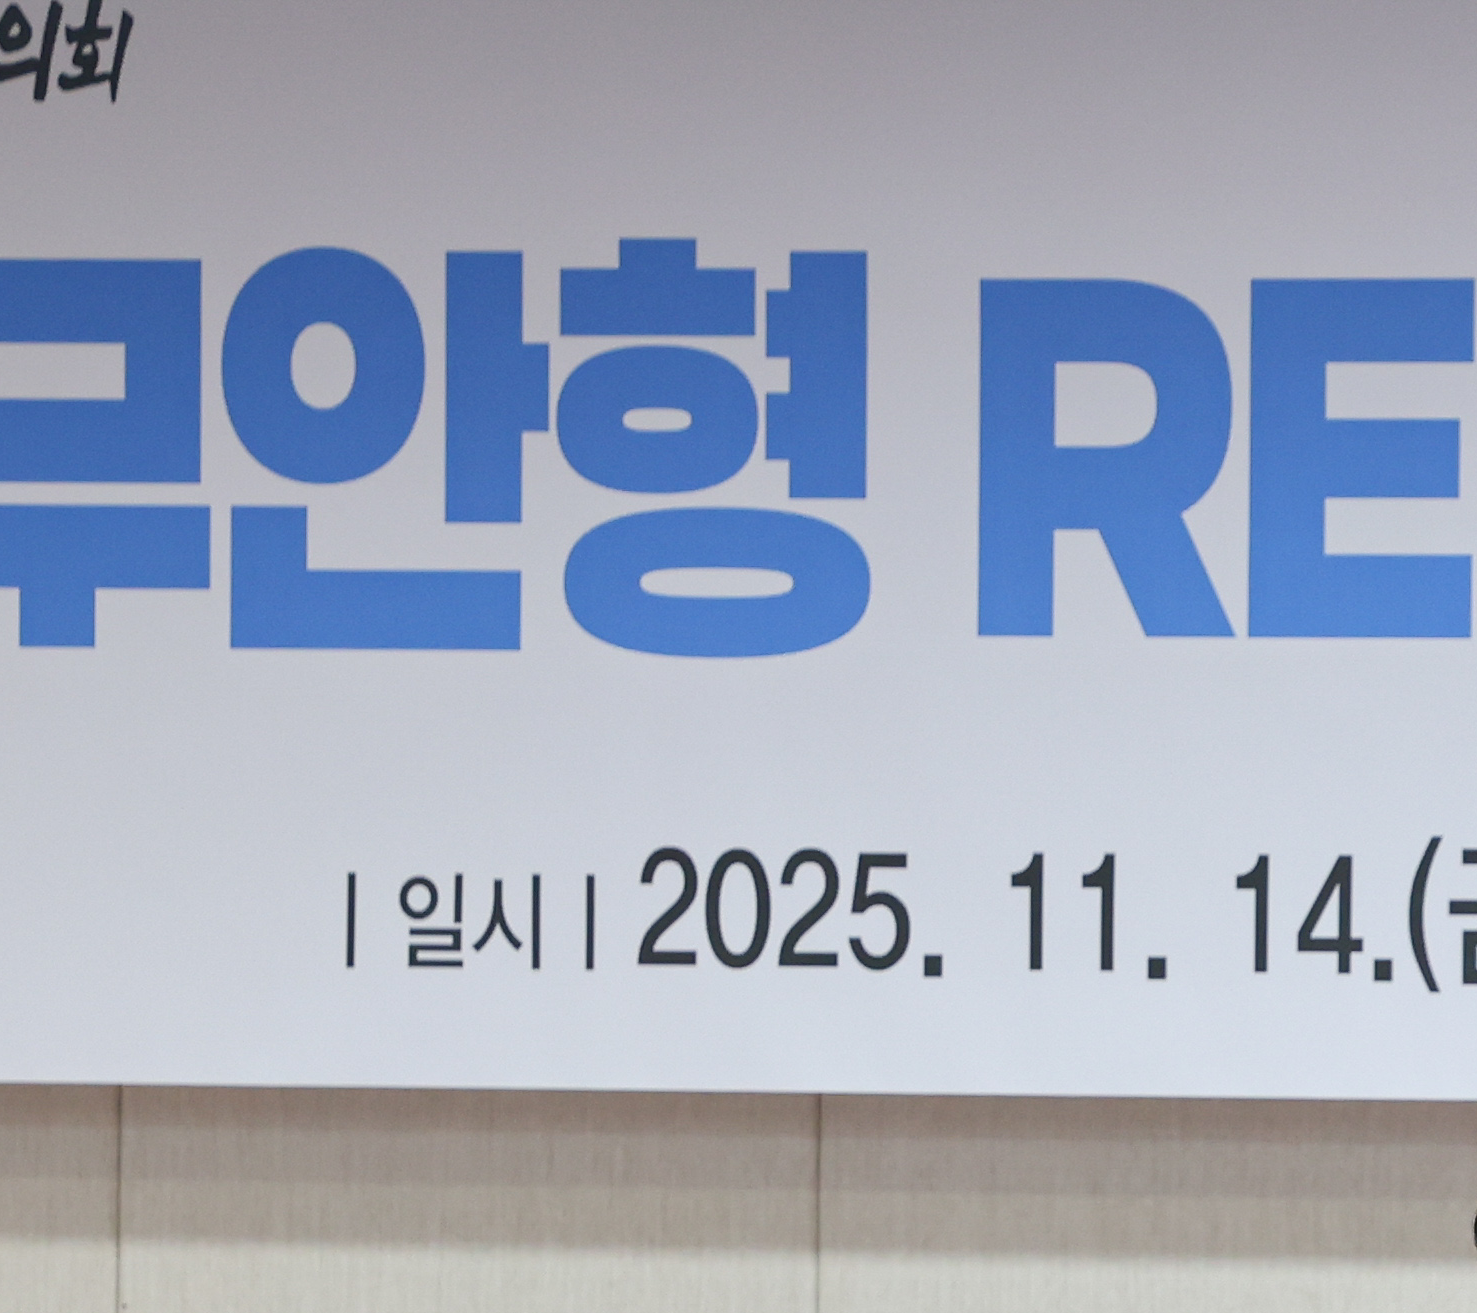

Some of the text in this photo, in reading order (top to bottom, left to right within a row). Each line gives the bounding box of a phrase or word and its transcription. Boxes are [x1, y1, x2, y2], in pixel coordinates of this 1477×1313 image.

[397, 872, 543, 971] 일시
[635, 845, 945, 979] 2025.
[1009, 851, 1169, 981] 11.
